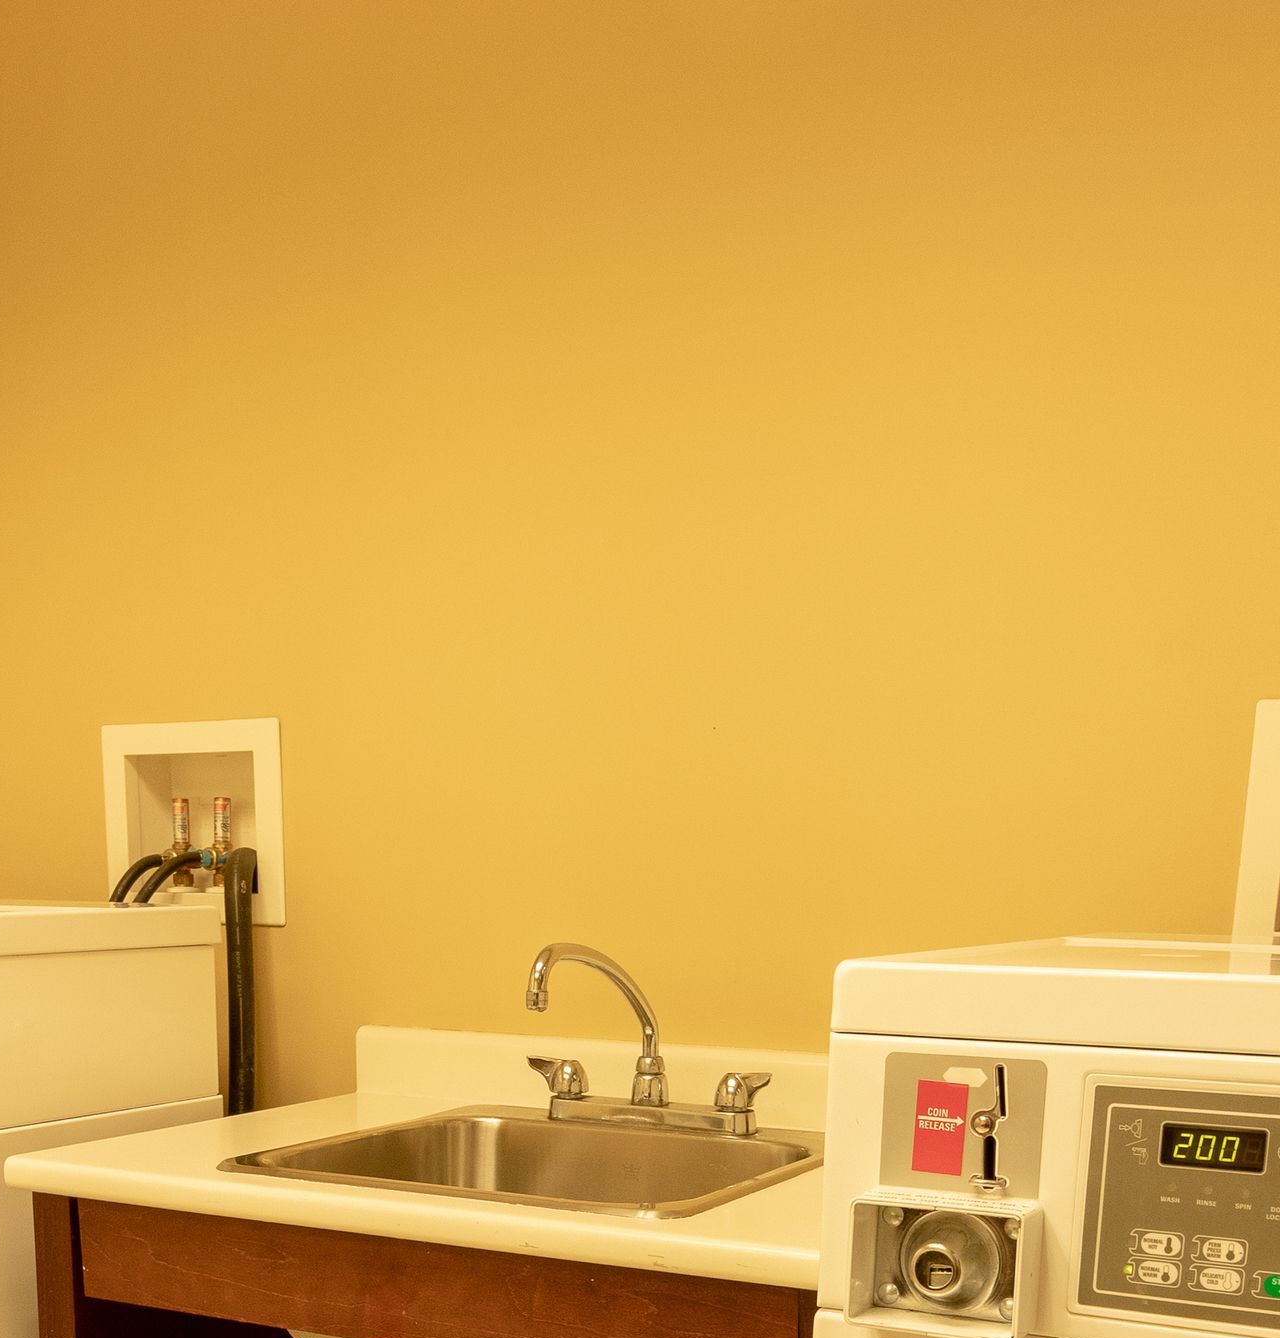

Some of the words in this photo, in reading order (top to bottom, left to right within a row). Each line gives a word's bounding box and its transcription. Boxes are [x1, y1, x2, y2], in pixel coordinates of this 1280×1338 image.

[927, 1107, 949, 1118] COIN
[918, 1120, 956, 1132] RELEASE
[1173, 1133, 1239, 1162] 200
